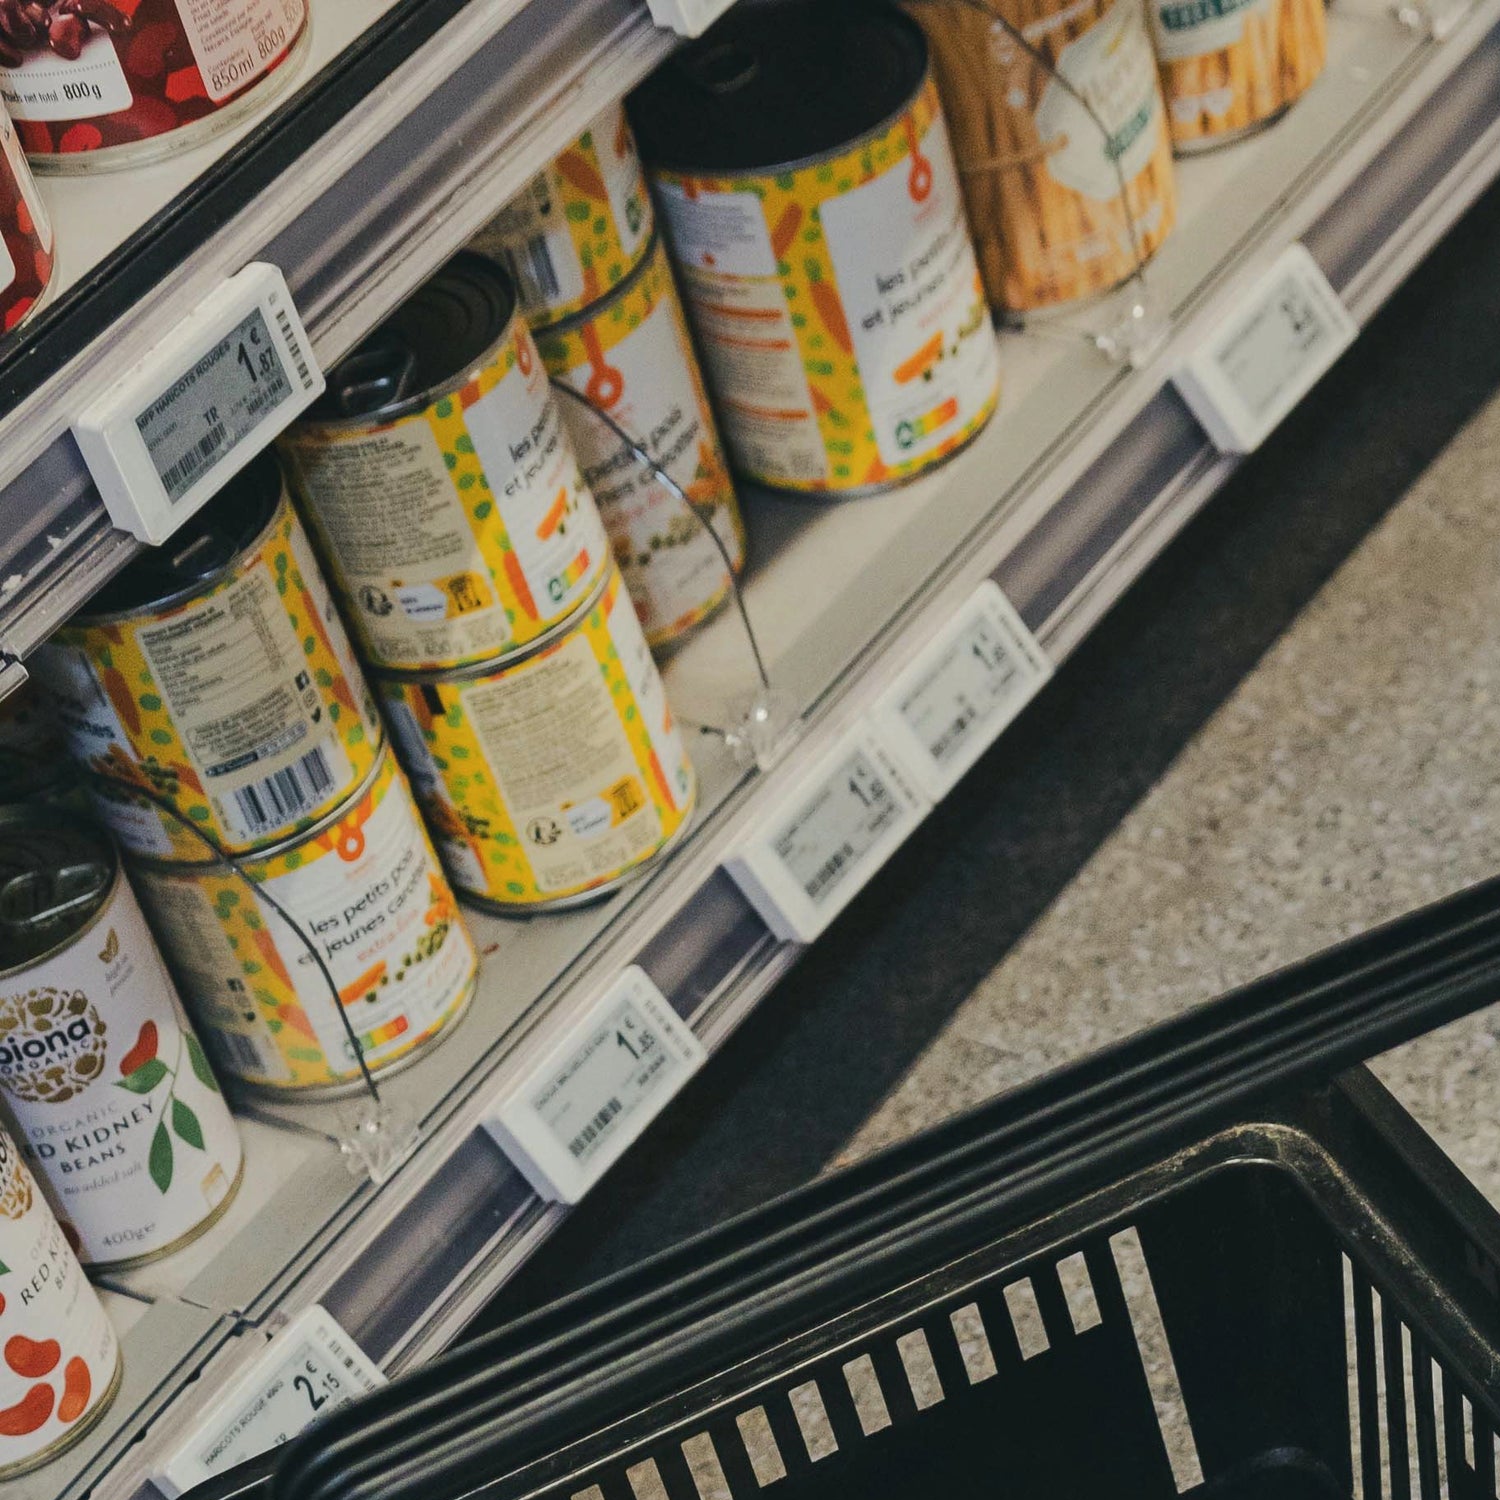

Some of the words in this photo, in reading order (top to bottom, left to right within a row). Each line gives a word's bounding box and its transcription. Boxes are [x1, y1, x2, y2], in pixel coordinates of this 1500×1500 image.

[257, 26, 286, 60] 800g
[62, 81, 90, 100] 800
[211, 51, 255, 92] 850ml
[309, 915, 340, 935] les
[343, 882, 390, 924] petits
[326, 914, 385, 960] jeunes
[0, 1038, 90, 1075] ORGANIC
[32, 1101, 119, 1138] ORGANIC
[65, 1098, 154, 1153] KIDNEY
[60, 1143, 126, 1174] BEANS
[20, 1263, 50, 1306] RED
[204, 1427, 241, 1467] HARICOTS
